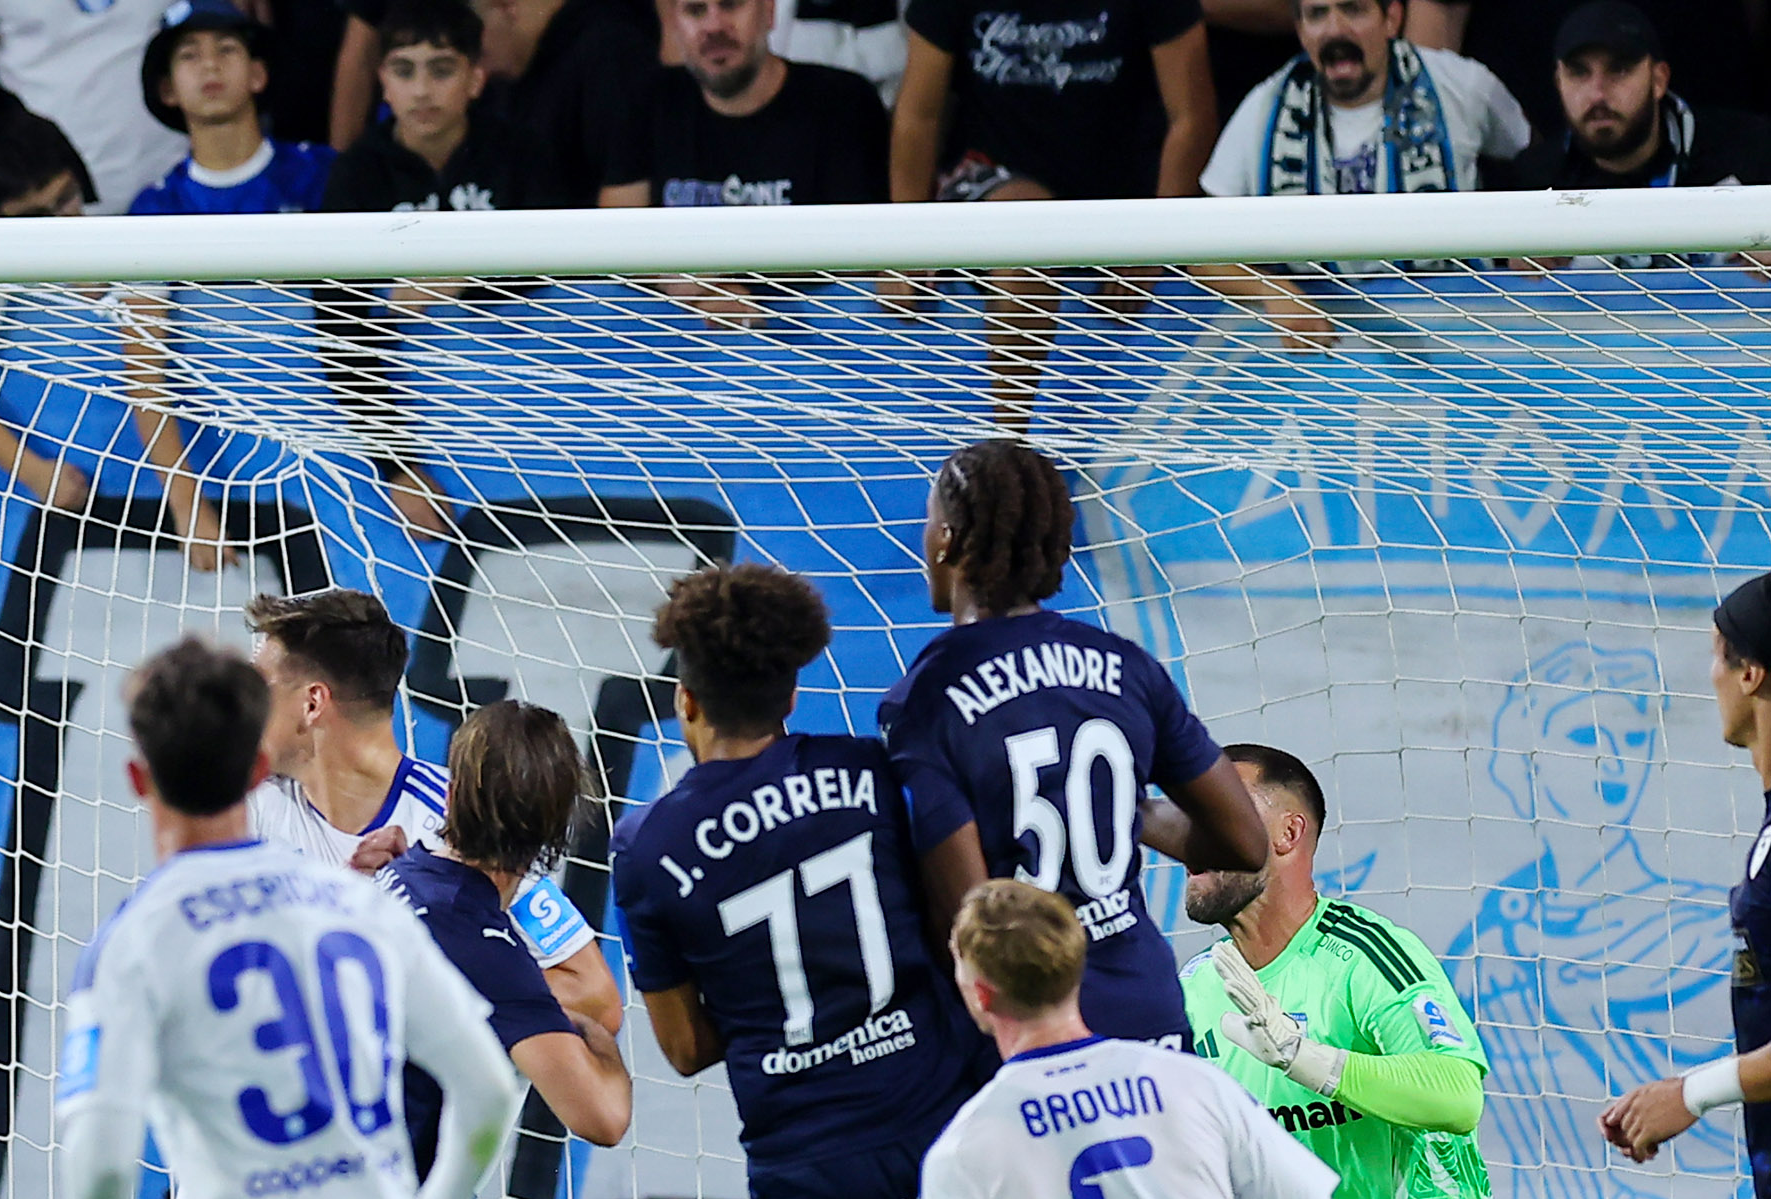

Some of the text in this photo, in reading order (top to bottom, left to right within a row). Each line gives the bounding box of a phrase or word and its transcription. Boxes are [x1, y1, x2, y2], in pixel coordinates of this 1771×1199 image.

[946, 643, 1123, 725] ALEXANDRE
[660, 768, 878, 898] J. CORREIA
[1004, 717, 1136, 900] 50
[717, 831, 895, 1047] 77
[208, 930, 392, 1146] 30
[762, 1009, 913, 1075] domenica
[850, 1031, 916, 1066] homes
[1020, 1075, 1164, 1137] BROWN
